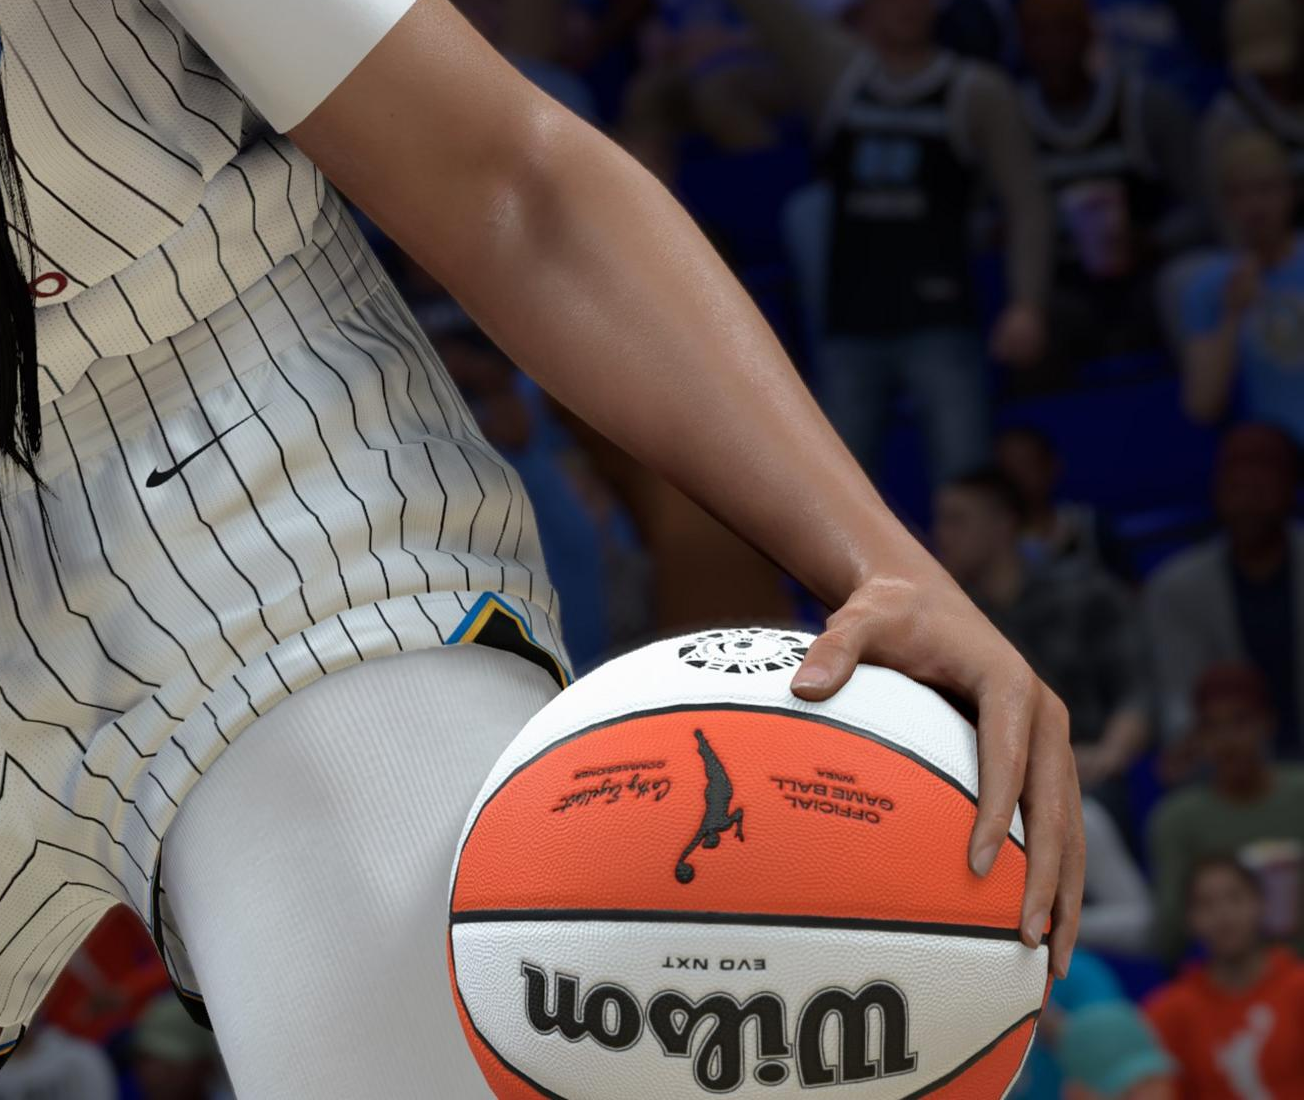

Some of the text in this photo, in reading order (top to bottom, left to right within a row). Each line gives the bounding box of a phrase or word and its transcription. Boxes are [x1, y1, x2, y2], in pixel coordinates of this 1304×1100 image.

[770, 778, 894, 812] GAME BALL
[784, 796, 881, 825] OFFICIAL
[661, 956, 766, 971] EVO NXT
[521, 961, 918, 1093] Wilson
